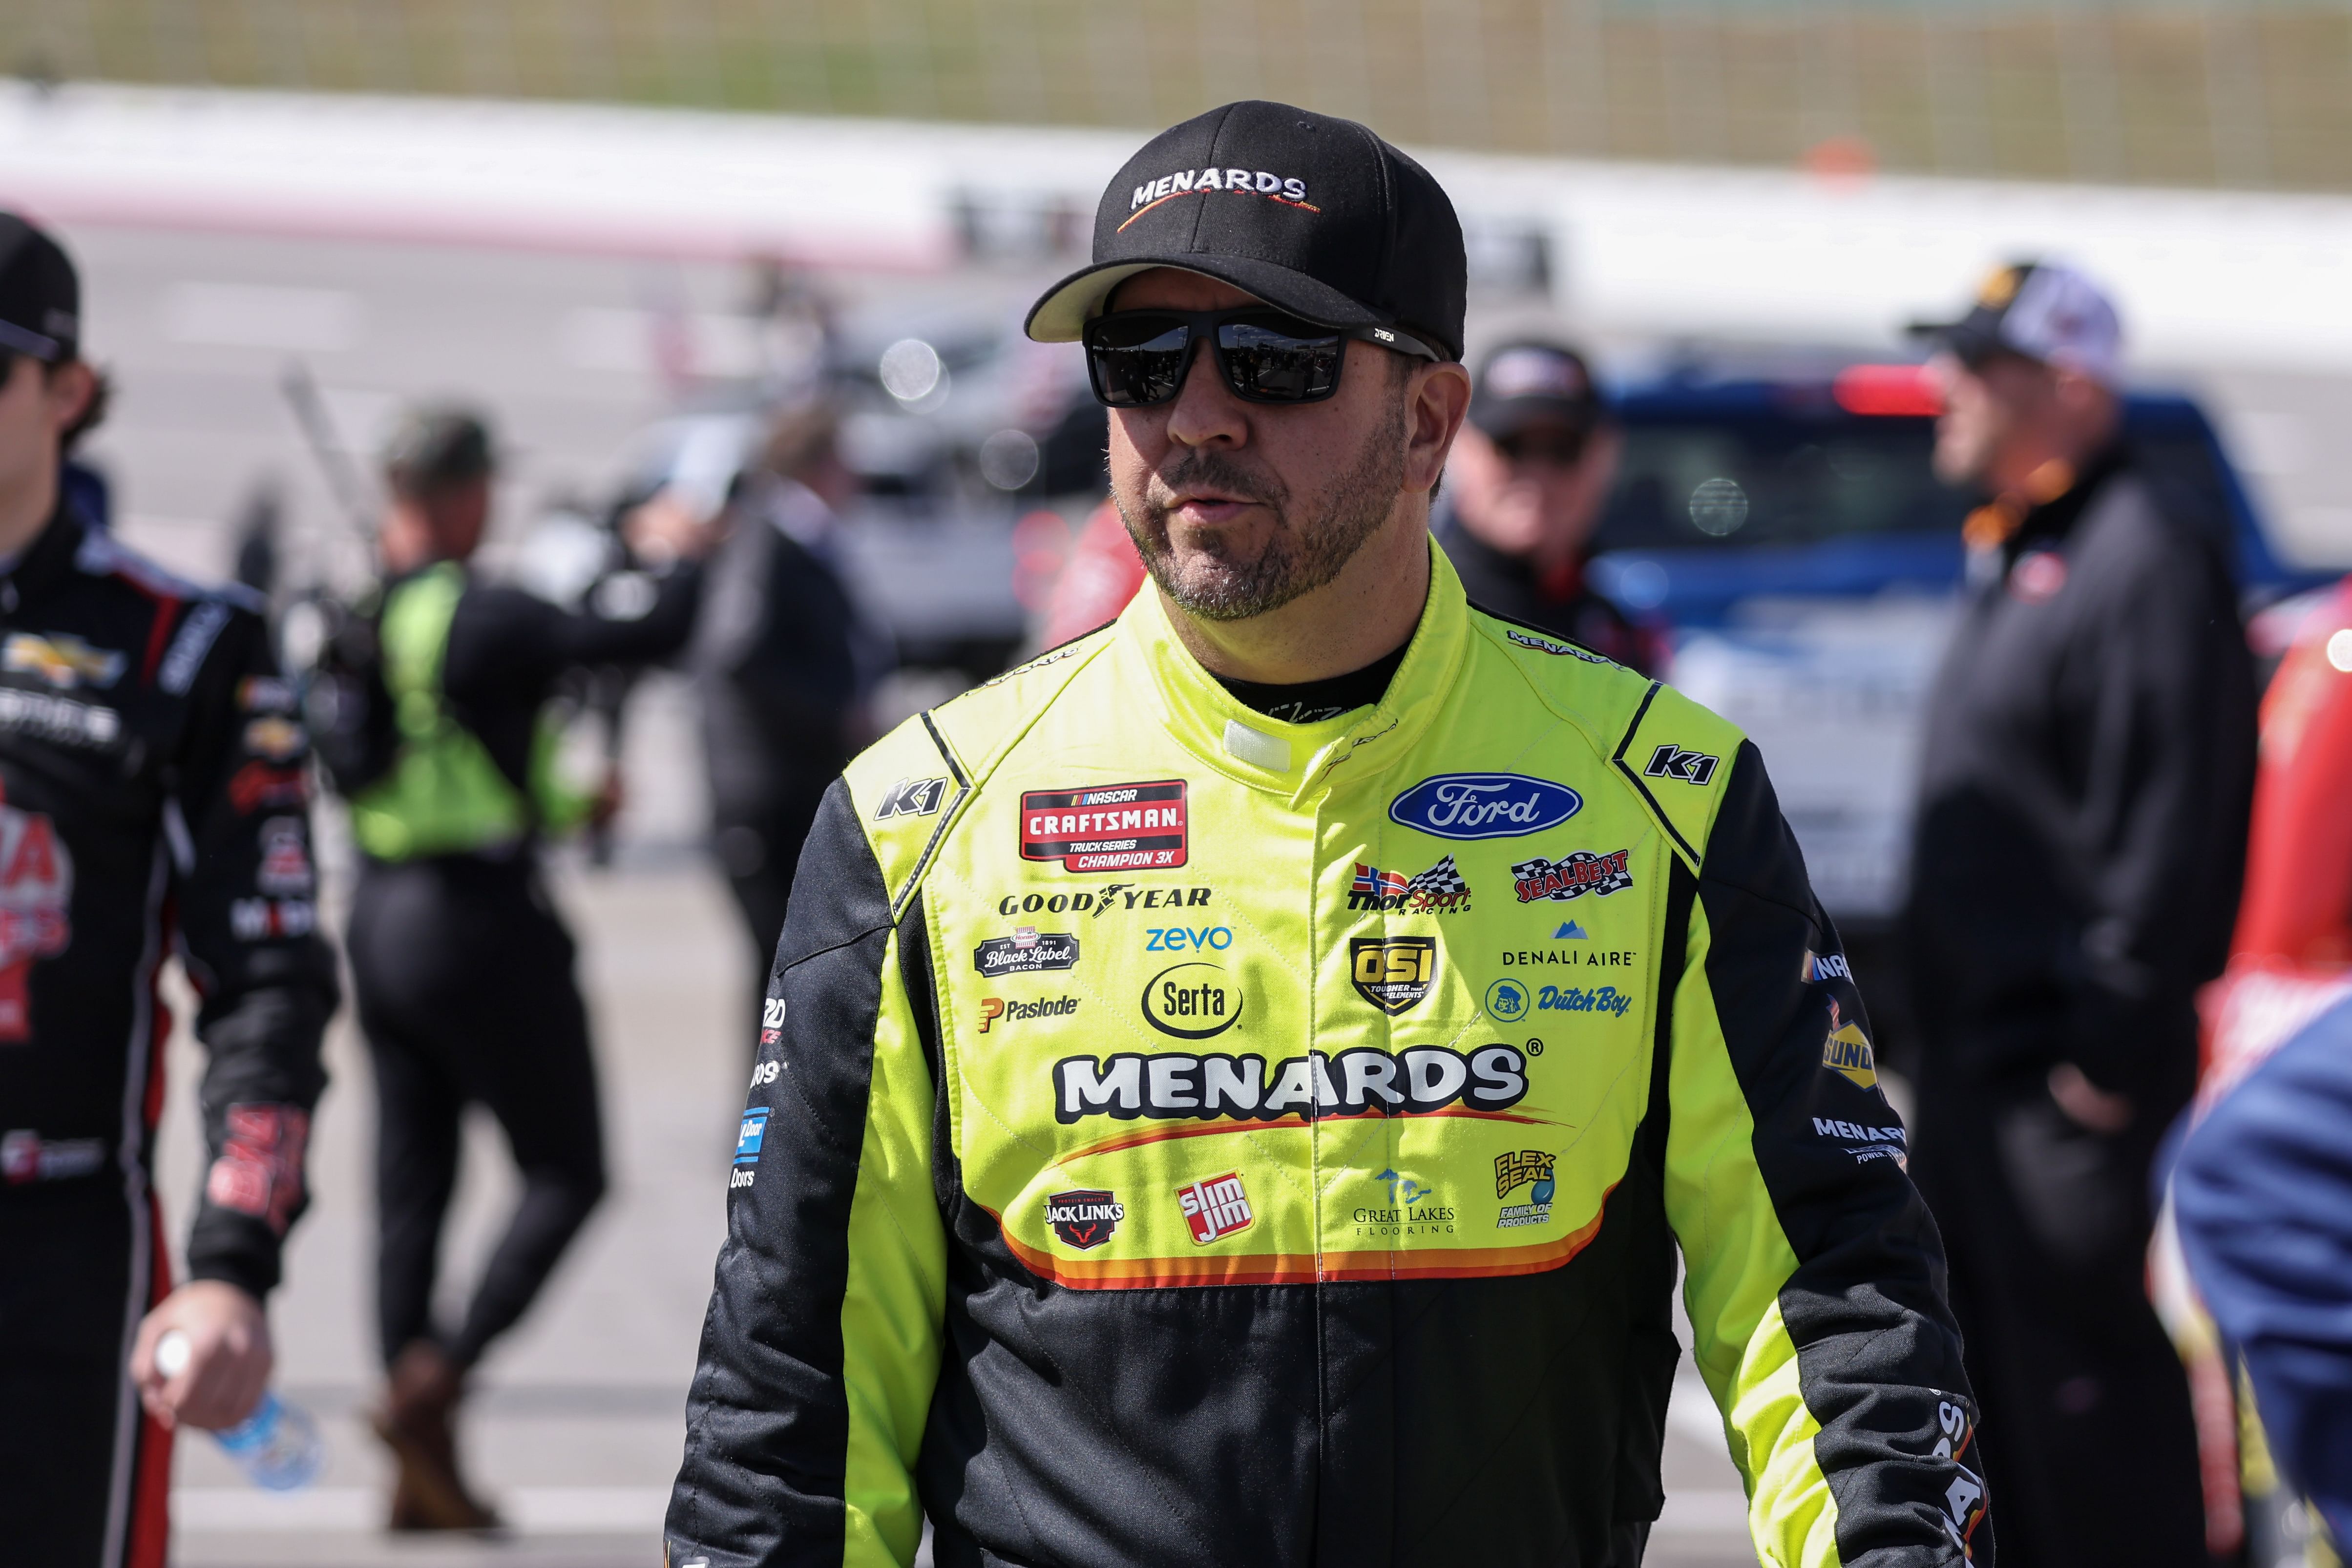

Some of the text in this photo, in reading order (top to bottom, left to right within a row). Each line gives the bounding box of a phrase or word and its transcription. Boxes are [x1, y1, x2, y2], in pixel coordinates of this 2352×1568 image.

[1129, 167, 1308, 212] MENARDS
[1374, 328, 1394, 342] DRIVEN
[1644, 745, 1719, 785] K1
[874, 777, 948, 821] K1
[1087, 789, 1137, 805] NASCAR
[1427, 782, 1540, 827] Ford
[1030, 808, 1176, 835] CRAFTSMAN
[1078, 851, 1175, 868] CHAMPION 3X
[1516, 850, 1627, 902] SEALBEST
[1347, 887, 1471, 912] ThorSport
[1398, 905, 1471, 915] RACING
[985, 949, 1028, 968] Black
[1355, 949, 1433, 983] OSI
[1502, 950, 1632, 966] DENALI AIRE
[1164, 982, 1224, 1016] Serta
[1370, 984, 1410, 993] TOUGHER
[1007, 996, 1077, 1022] Paslode
[1538, 985, 1632, 1018] Dutch Boy
[1054, 1045, 1529, 1123] MENARDS
[744, 1120, 762, 1137] Door
[1495, 1150, 1556, 1178] FLEX
[731, 1168, 755, 1188] Doors
[1497, 1167, 1551, 1198] SEAL
[1045, 1203, 1124, 1223] JACK LINK'S
[1497, 1214, 1550, 1228] PRODUCTS
[1500, 1203, 1553, 1218] FAMILY OF
[1357, 1225, 1454, 1235] FLOORING
